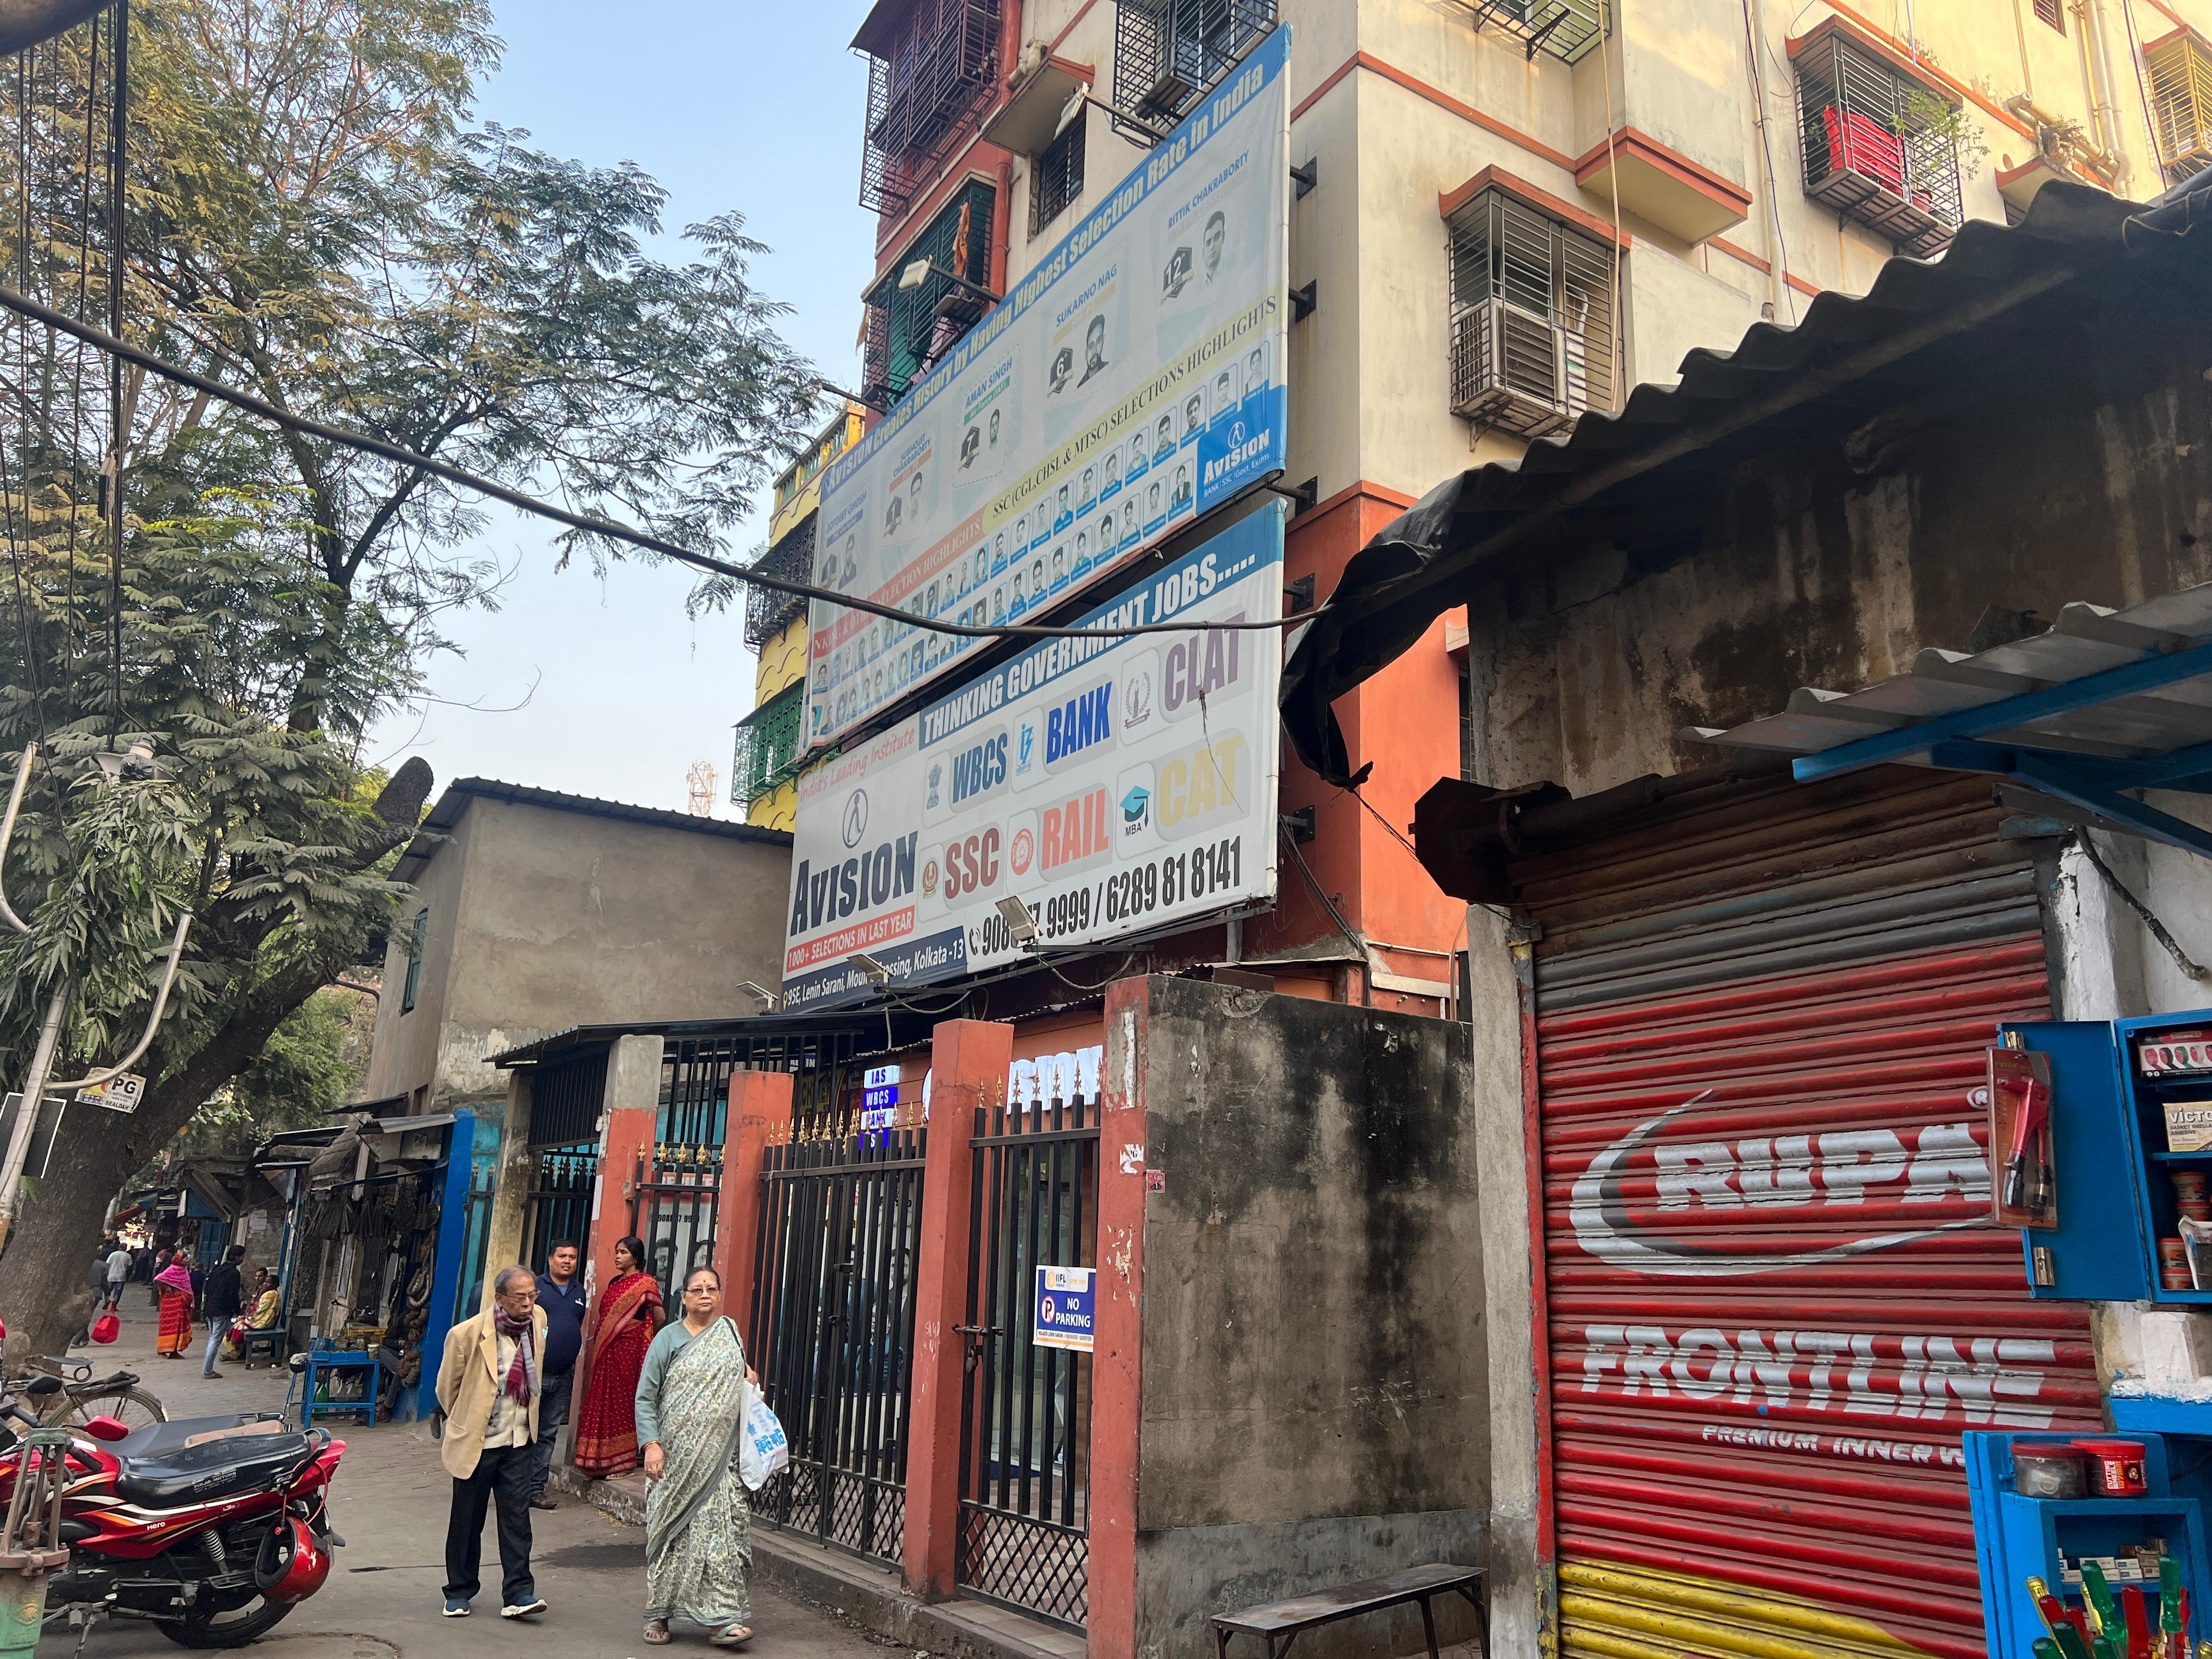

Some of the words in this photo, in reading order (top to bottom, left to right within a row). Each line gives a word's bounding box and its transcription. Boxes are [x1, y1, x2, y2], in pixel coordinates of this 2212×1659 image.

[1168, 201, 1191, 229] RITTIK
[1192, 149, 1249, 208] CHAKRABORTY
[827, 434, 873, 493] AVISION
[873, 407, 911, 450] Creates
[913, 364, 952, 415] History
[953, 345, 969, 375] by
[970, 307, 1012, 359] Having
[1014, 250, 1067, 317] Highest
[1069, 174, 1144, 262] Selection
[1147, 135, 1187, 189] Rate
[1189, 115, 1209, 152] in
[1212, 63, 1263, 132] India
[1056, 283, 1096, 328] SUKARNO
[1098, 263, 1117, 290] NAG
[965, 380, 987, 410] AMAN
[988, 357, 1013, 388] SINGH
[978, 392, 992, 414] Force
[992, 492, 1011, 518] SSC
[1012, 454, 1062, 507] (CGL,CHSL
[1063, 448, 1071, 465] &
[1074, 421, 1109, 455] MTSC)
[1109, 362, 1184, 431] SELECTIONS
[1187, 295, 1277, 374] HIGHLIGHTS
[893, 437, 931, 477] CHAKRABORTY
[900, 433, 926, 460] SUBHOJIT
[1204, 427, 1269, 485] AVISION
[1204, 481, 1219, 498] BANK
[1222, 473, 1233, 487] SSC
[1235, 464, 1250, 478] Govt.
[1251, 453, 1270, 469] Exams
[826, 509, 848, 534] JOYDEEP
[848, 490, 866, 516] GHOSH
[815, 627, 842, 651] NKING
[850, 608, 871, 630] OTH
[923, 518, 981, 575] HIGHLIGHTS
[924, 673, 1003, 744] THINKING
[1007, 590, 1149, 699] GOVERNMENT
[952, 732, 1008, 804] WBCS
[1015, 761, 1032, 775] IBPS
[1046, 681, 1113, 764] BANK
[1164, 611, 1245, 712] CLAT
[799, 774, 827, 802] India's
[830, 755, 868, 787] Leading
[871, 727, 915, 764] Institute
[944, 827, 1000, 900] SSC
[1041, 788, 1109, 871] RAIL
[1125, 822, 1142, 837] MBA
[1158, 733, 1244, 828] CAT
[790, 831, 918, 937] AVISION
[982, 914, 1011, 956] 908
[1047, 886, 1091, 938] 9999
[1093, 882, 1103, 928] /
[1106, 861, 1157, 923] 6289
[1163, 853, 1186, 907] 81
[1190, 835, 1241, 898] 8141
[788, 950, 809, 968] 1000+
[811, 929, 856, 960] SELECTIONS
[857, 927, 867, 946] IN
[868, 920, 889, 942] LAST
[890, 911, 912, 934] YEAR
[787, 989, 801, 1006] 95E,
[802, 979, 821, 1002] Lenin
[821, 972, 845, 997] Sarani,
[913, 945, 947, 972] Kolkata
[111, 1077, 137, 1094] PG
[866, 1089, 889, 1107] WBCS
[871, 1068, 886, 1085] IAS
[105, 1101, 129, 1110] SEALDAH
[1654, 1122, 1991, 1211] RUPA
[1056, 1273, 1066, 1283] IIFL
[1066, 1297, 1080, 1311] NO
[1056, 1312, 1091, 1328] PARKING
[1580, 1324, 2057, 1429] FRONTLINE
[1702, 1424, 1819, 1452] PREMIUM
[1833, 1437, 1933, 1464] INNER
[2104, 1460, 2113, 1489] CUTTING
[2110, 1460, 2119, 1489] WHEELS
[146, 1521, 166, 1531] Hero
